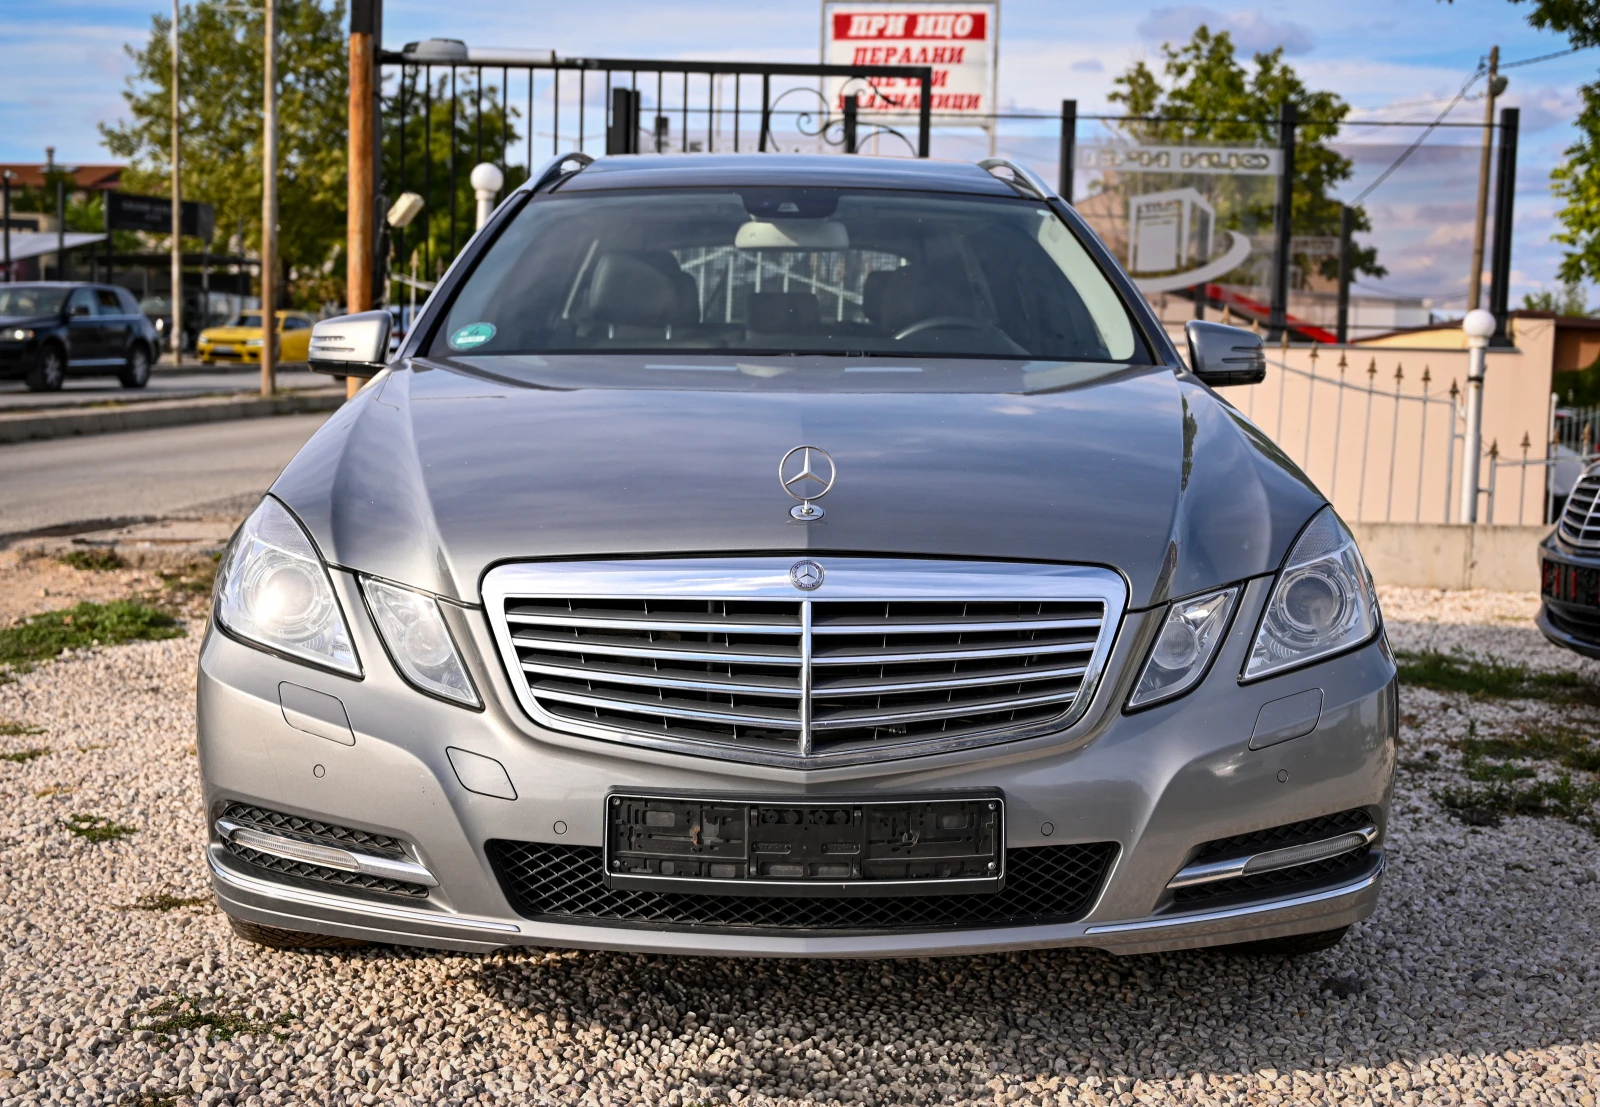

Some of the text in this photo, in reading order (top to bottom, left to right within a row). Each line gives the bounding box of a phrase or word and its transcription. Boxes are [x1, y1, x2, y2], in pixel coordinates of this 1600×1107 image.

[848, 15, 974, 38] ПРИ ИЦО
[852, 46, 966, 66] ПЕРАЛНИ
